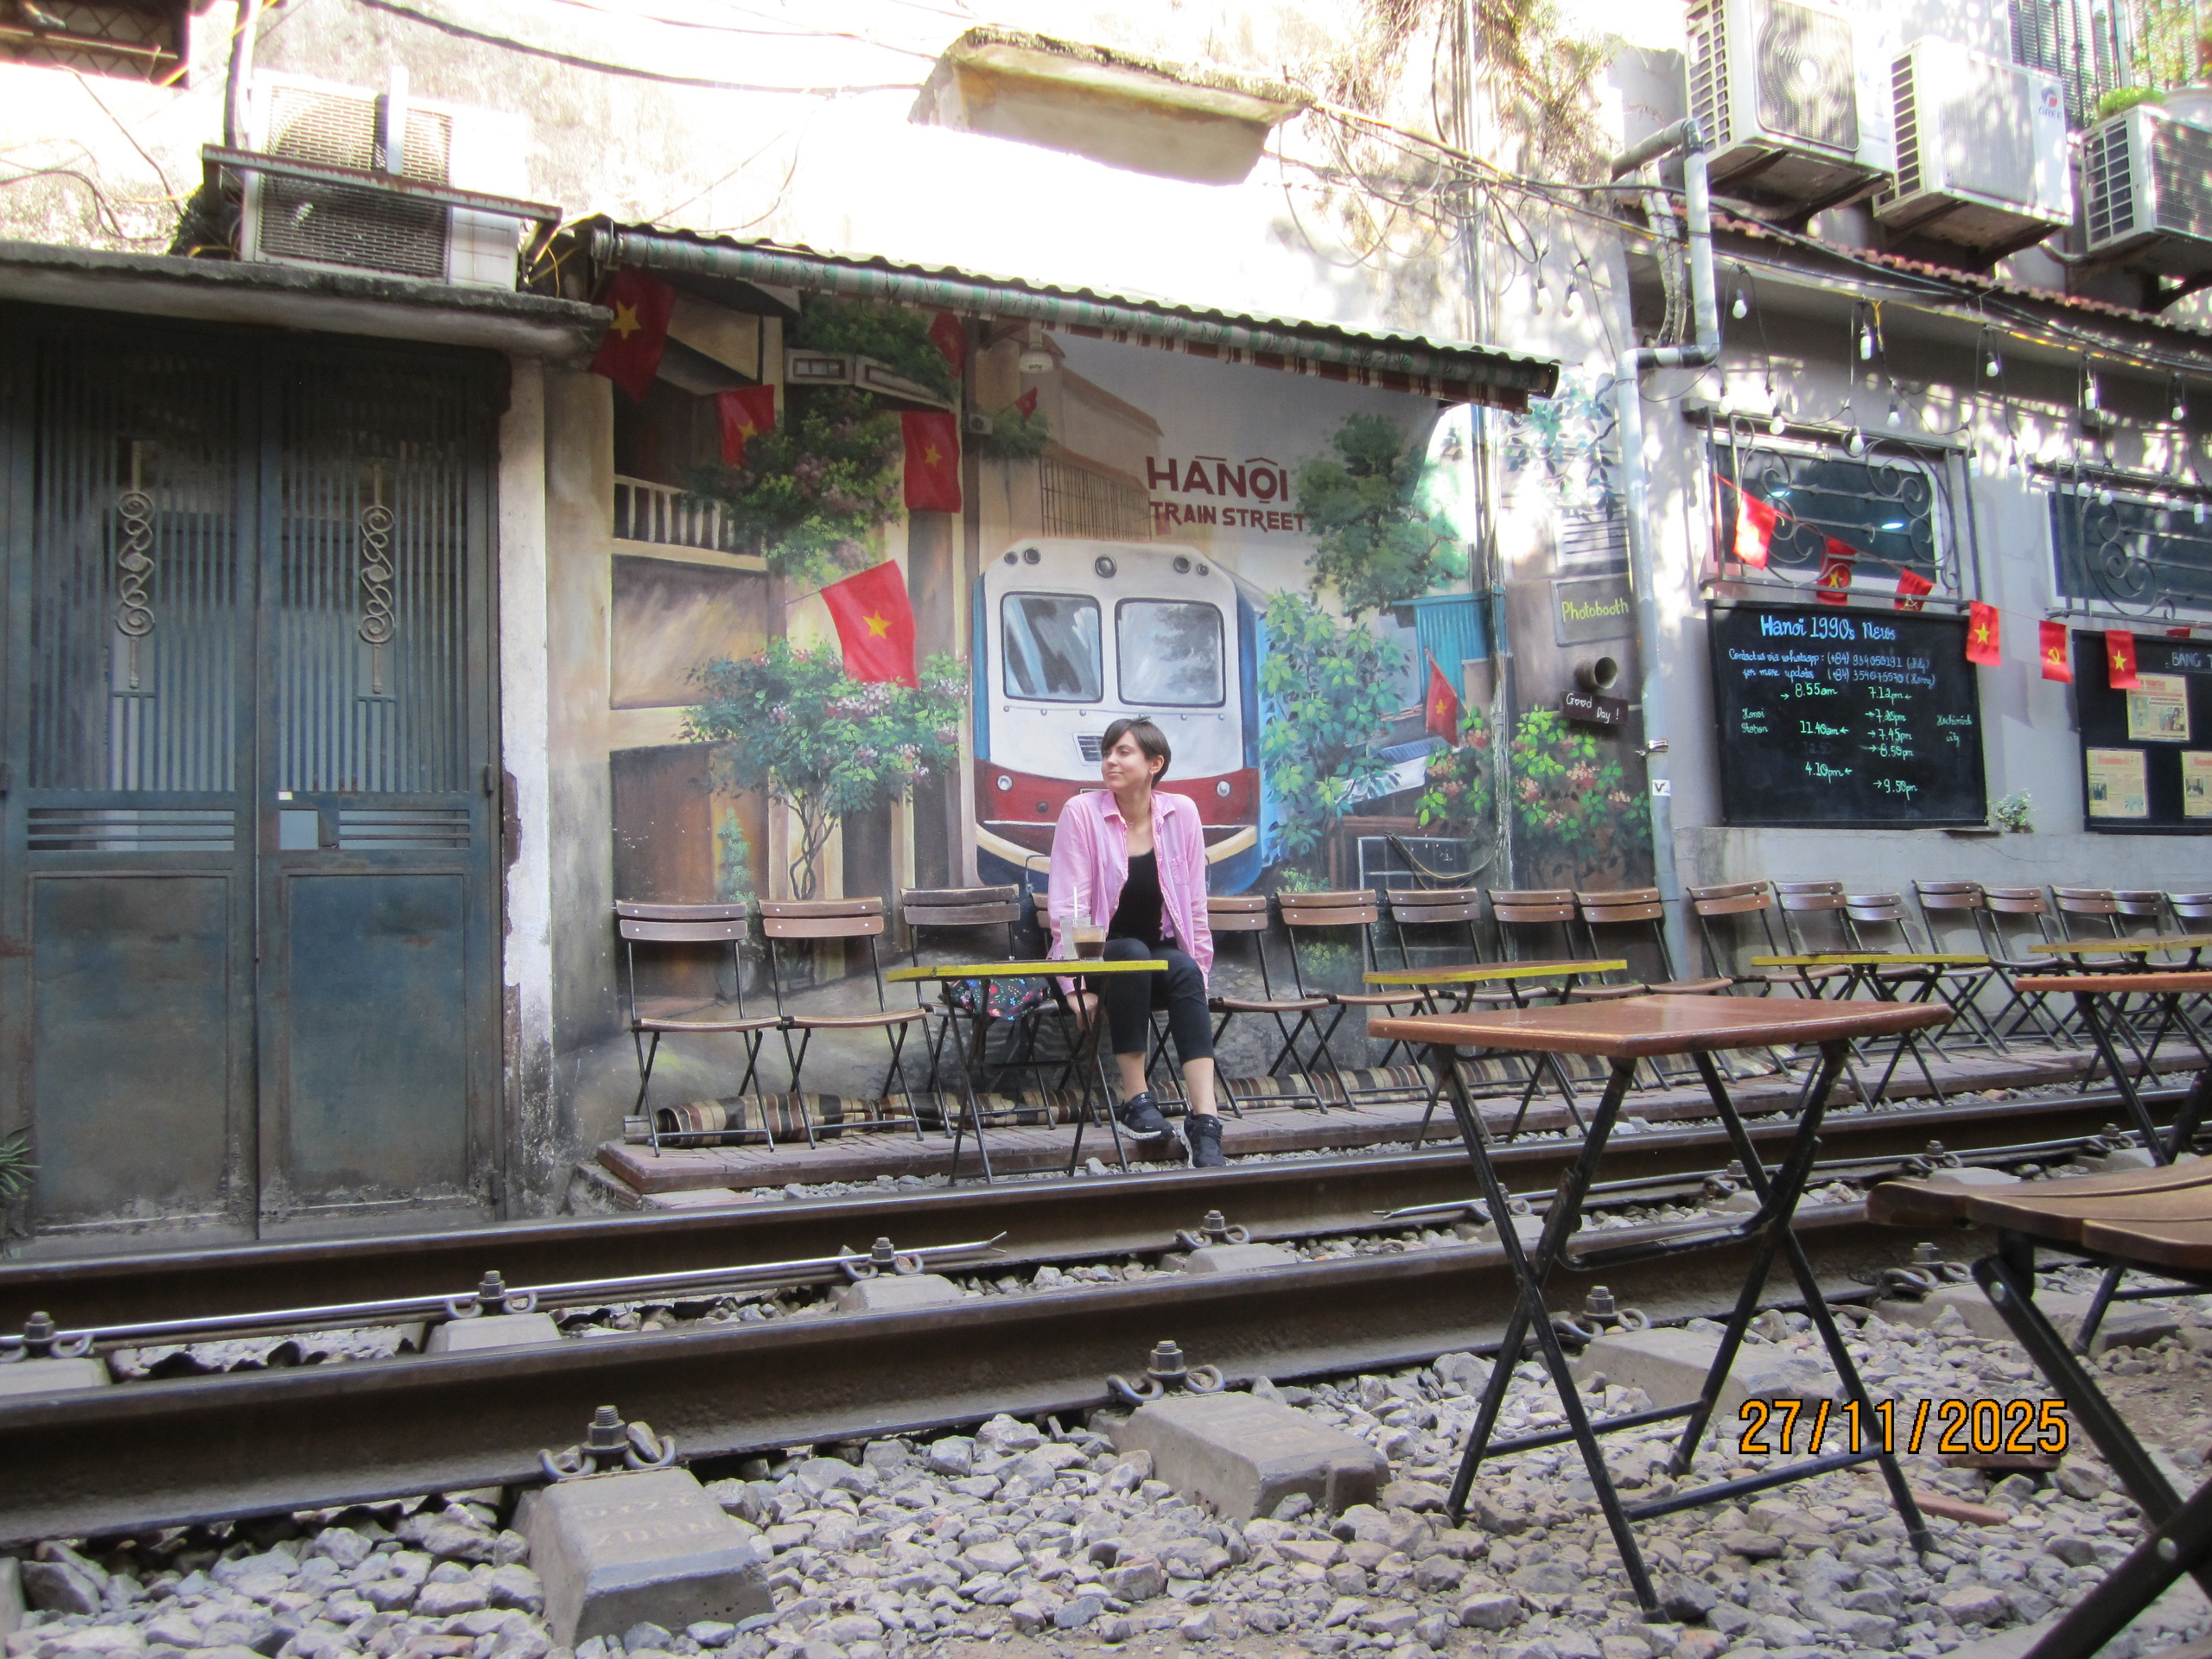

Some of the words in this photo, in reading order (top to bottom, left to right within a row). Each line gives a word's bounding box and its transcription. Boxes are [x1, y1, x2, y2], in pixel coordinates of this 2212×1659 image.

[1149, 501, 1217, 526] TRAIN
[1222, 507, 1306, 533] STREET
[1561, 598, 1630, 622] Photobooth
[1760, 614, 1807, 637] Hanoi
[1810, 617, 1856, 640] 1990s
[1767, 652, 1780, 662] via
[1784, 665, 1815, 683] updates
[1795, 683, 1838, 698] 8.55am
[1868, 686, 1904, 705] 7.12pm
[1597, 707, 1611, 724] Day
[1741, 722, 1769, 734] Station
[1800, 721, 1840, 735] 11.40am
[1878, 728, 1913, 743] 7.45pm
[1805, 761, 1845, 785] 4.10pm
[1884, 779, 1918, 801] 9.50pm
